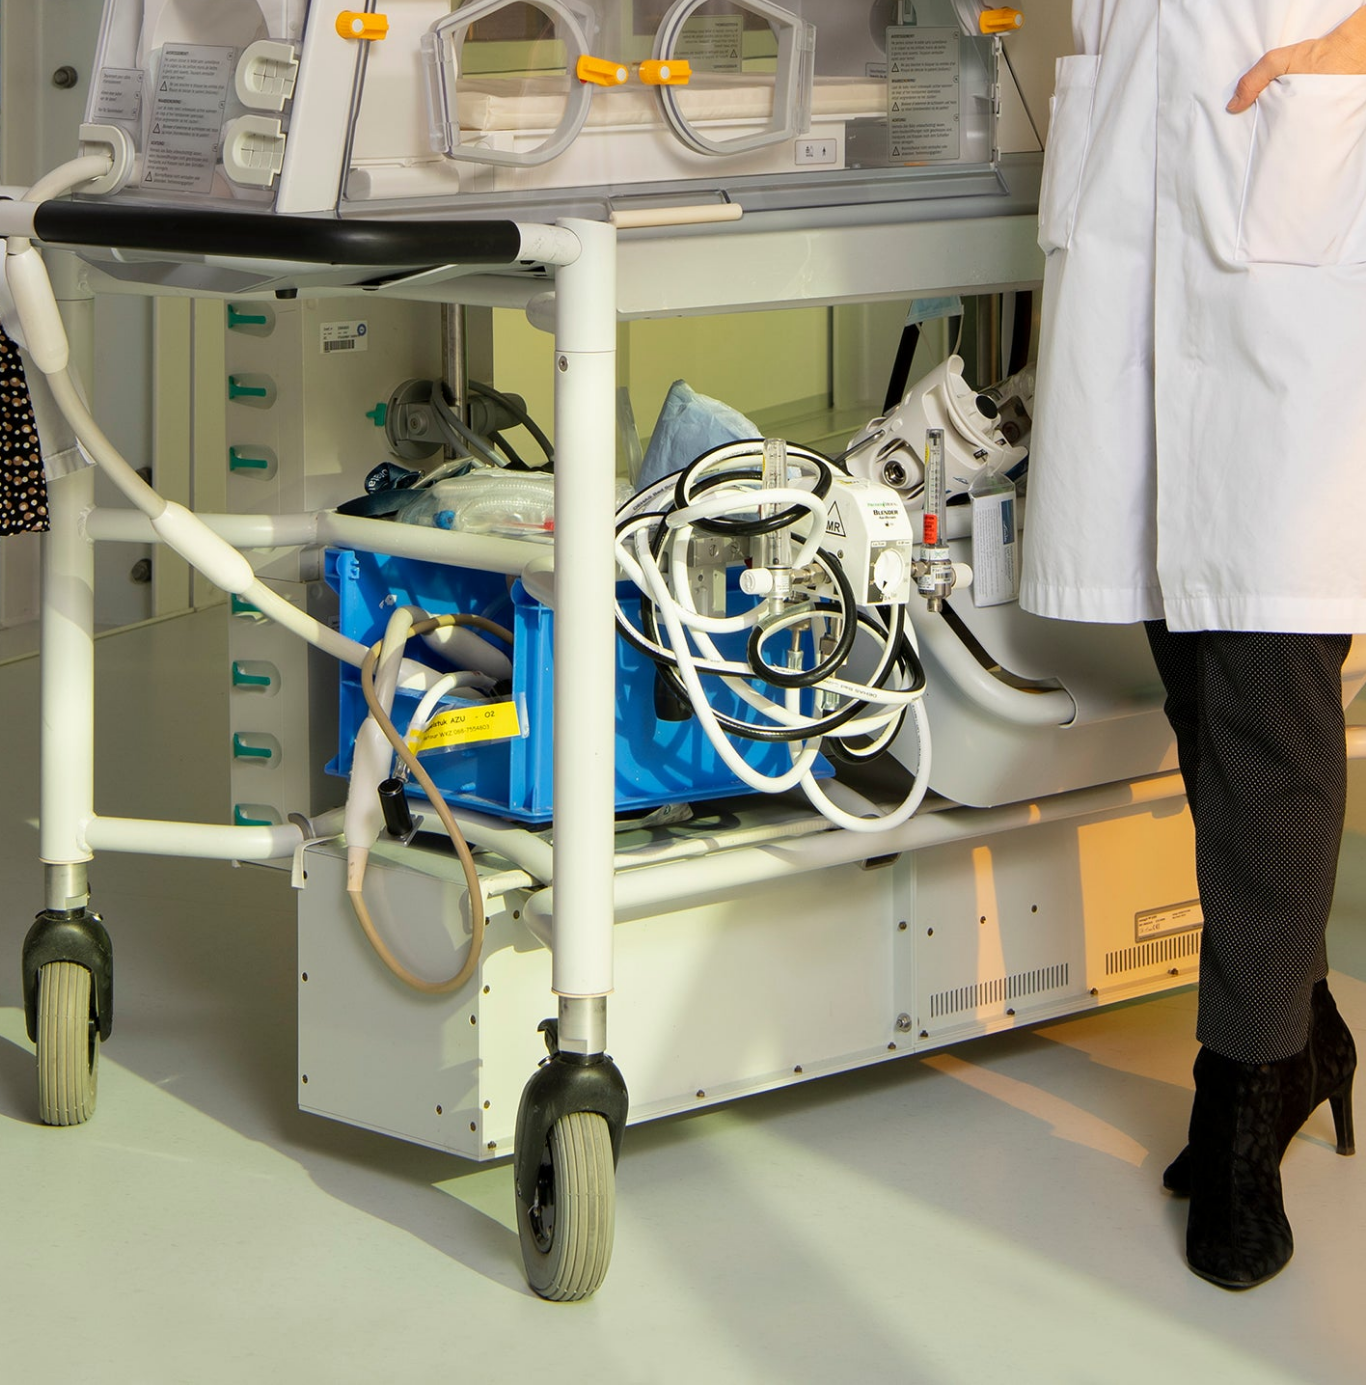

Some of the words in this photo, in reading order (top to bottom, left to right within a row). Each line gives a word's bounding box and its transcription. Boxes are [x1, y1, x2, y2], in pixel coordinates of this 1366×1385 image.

[826, 520, 841, 533] MR
[1353, 675, 1366, 689] U
[450, 715, 466, 723] AZU
